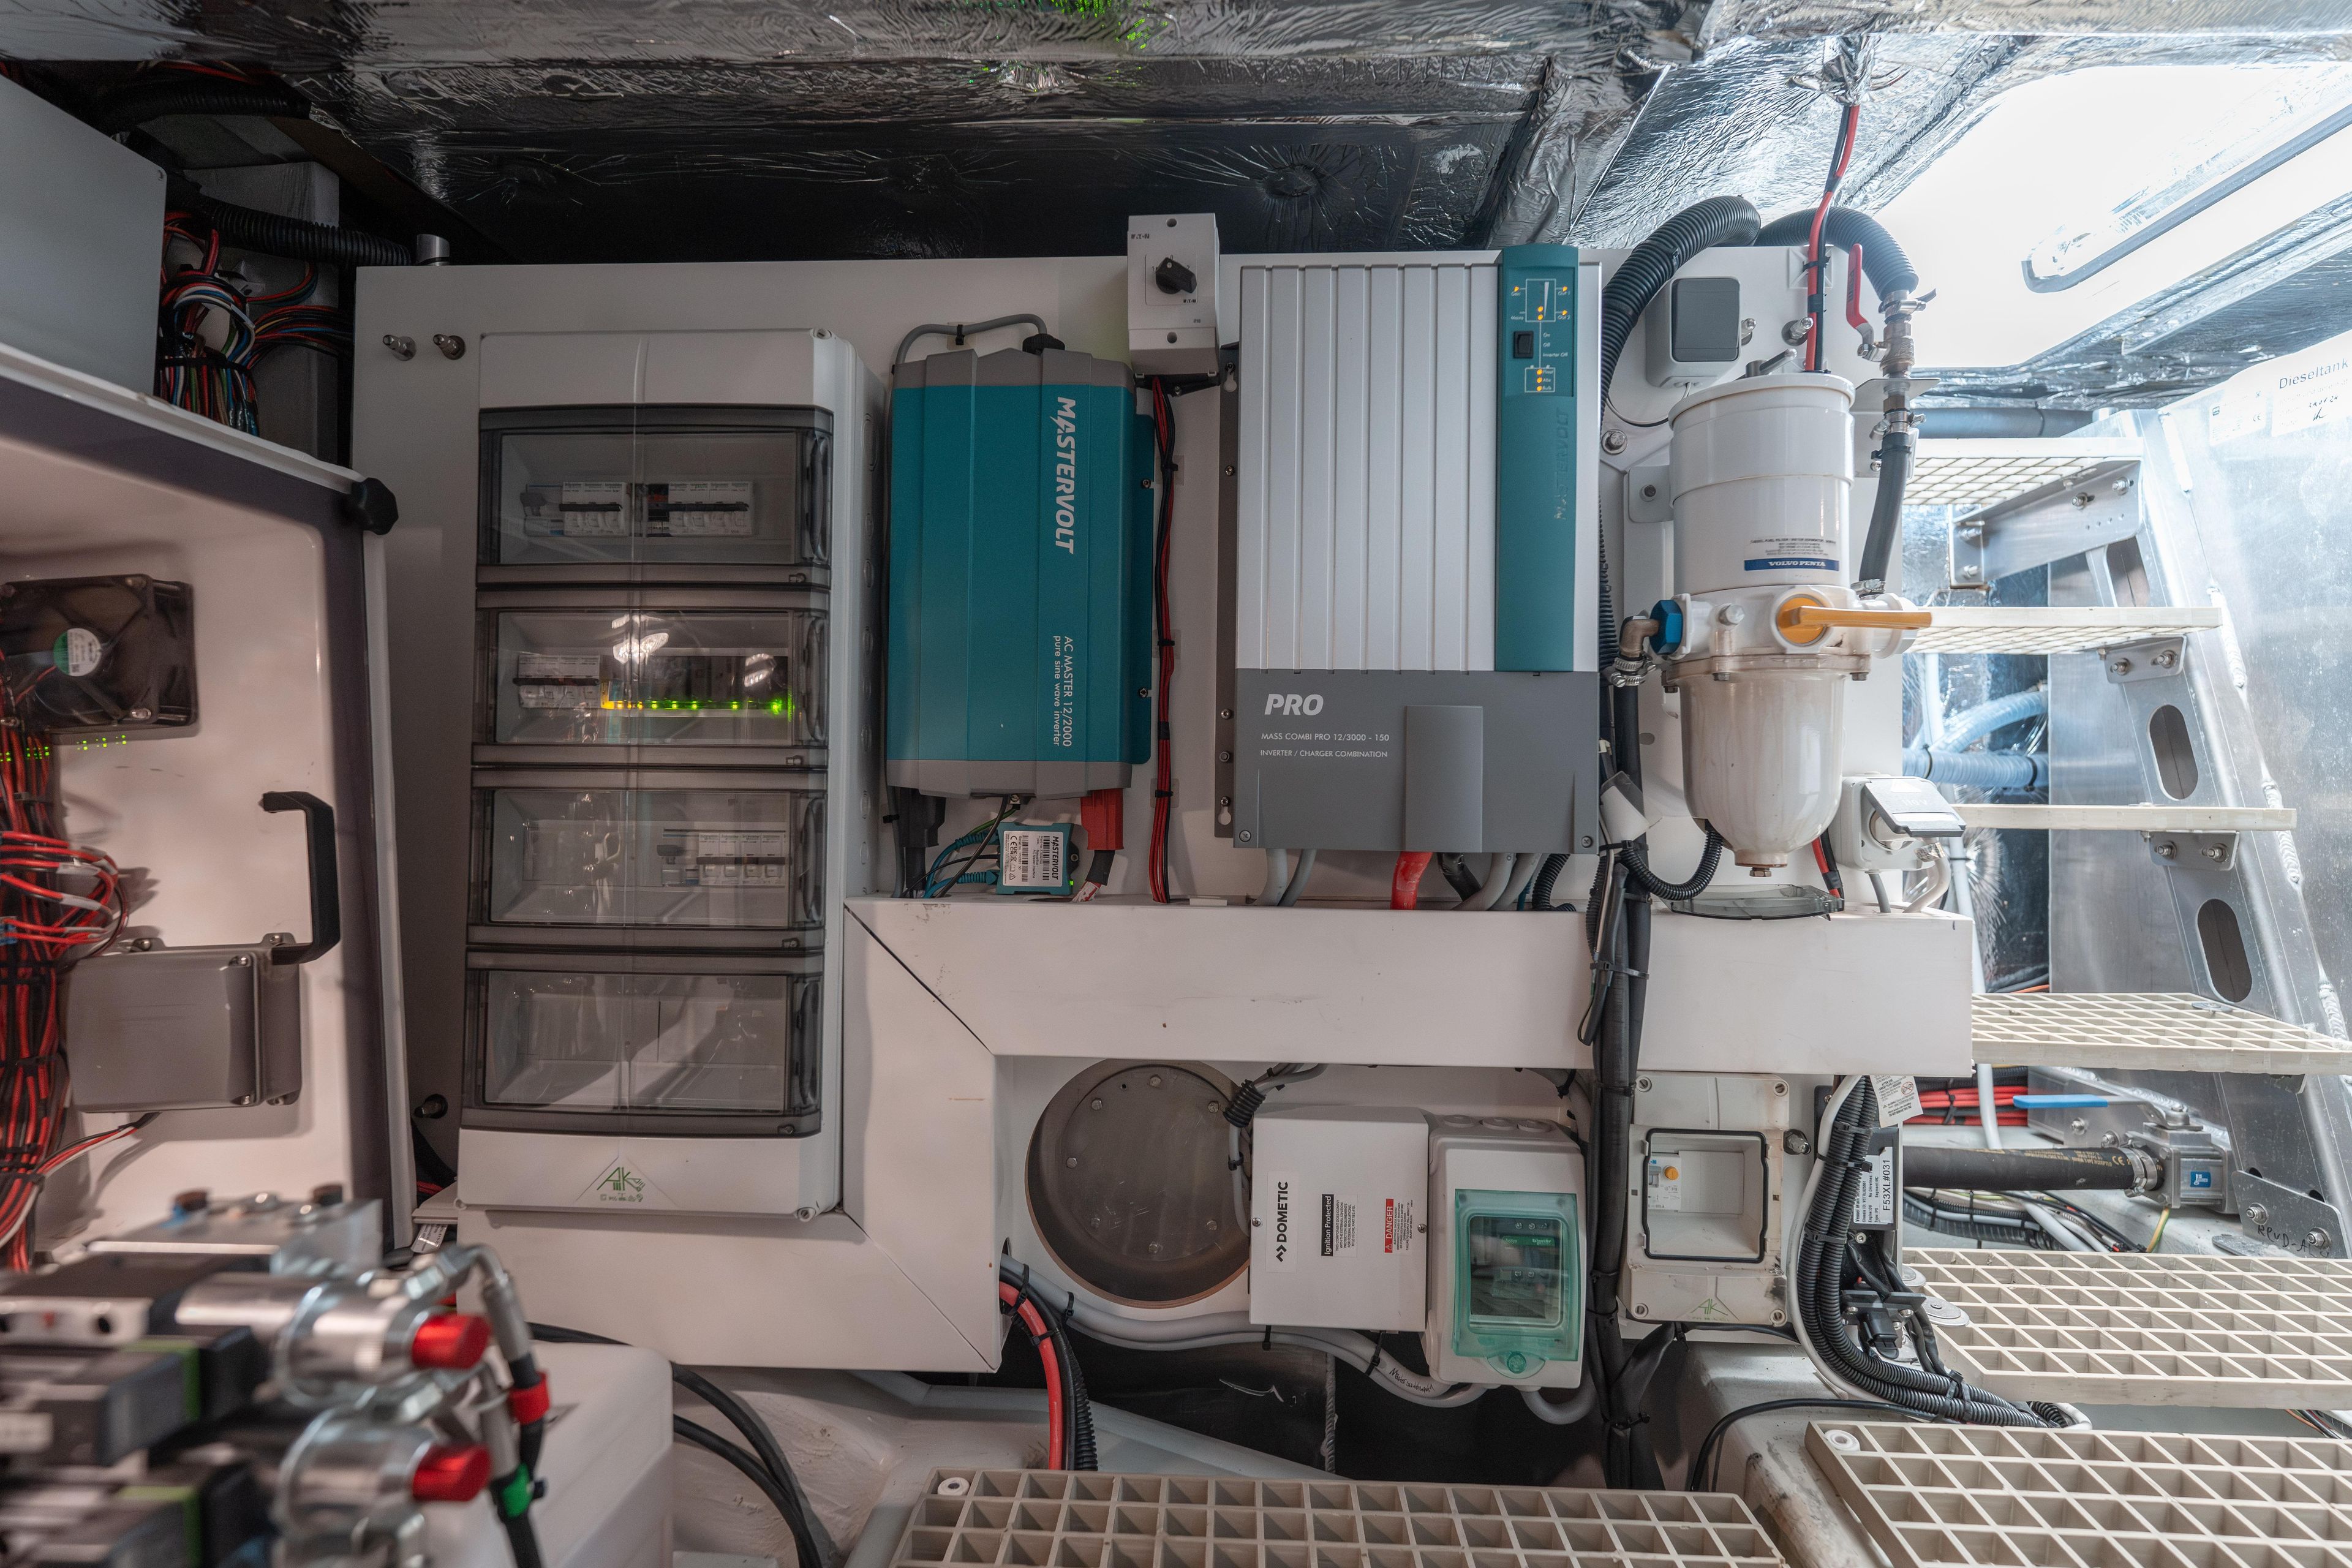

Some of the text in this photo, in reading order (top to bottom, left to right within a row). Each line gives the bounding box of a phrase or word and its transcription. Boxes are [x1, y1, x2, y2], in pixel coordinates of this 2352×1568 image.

[2279, 358, 2349, 389] Dieseltank
[1050, 396, 1077, 554] MASTERVOLT
[1063, 636, 1073, 747] AC MASTER 12/2000
[1264, 693, 1324, 716] PRO
[1261, 733, 1283, 741] MASS
[1285, 733, 1313, 741] COMBI
[1333, 733, 1366, 742] 12/3000
[1374, 734, 1390, 742] 150
[1276, 1181, 1289, 1243] DOMETIC
